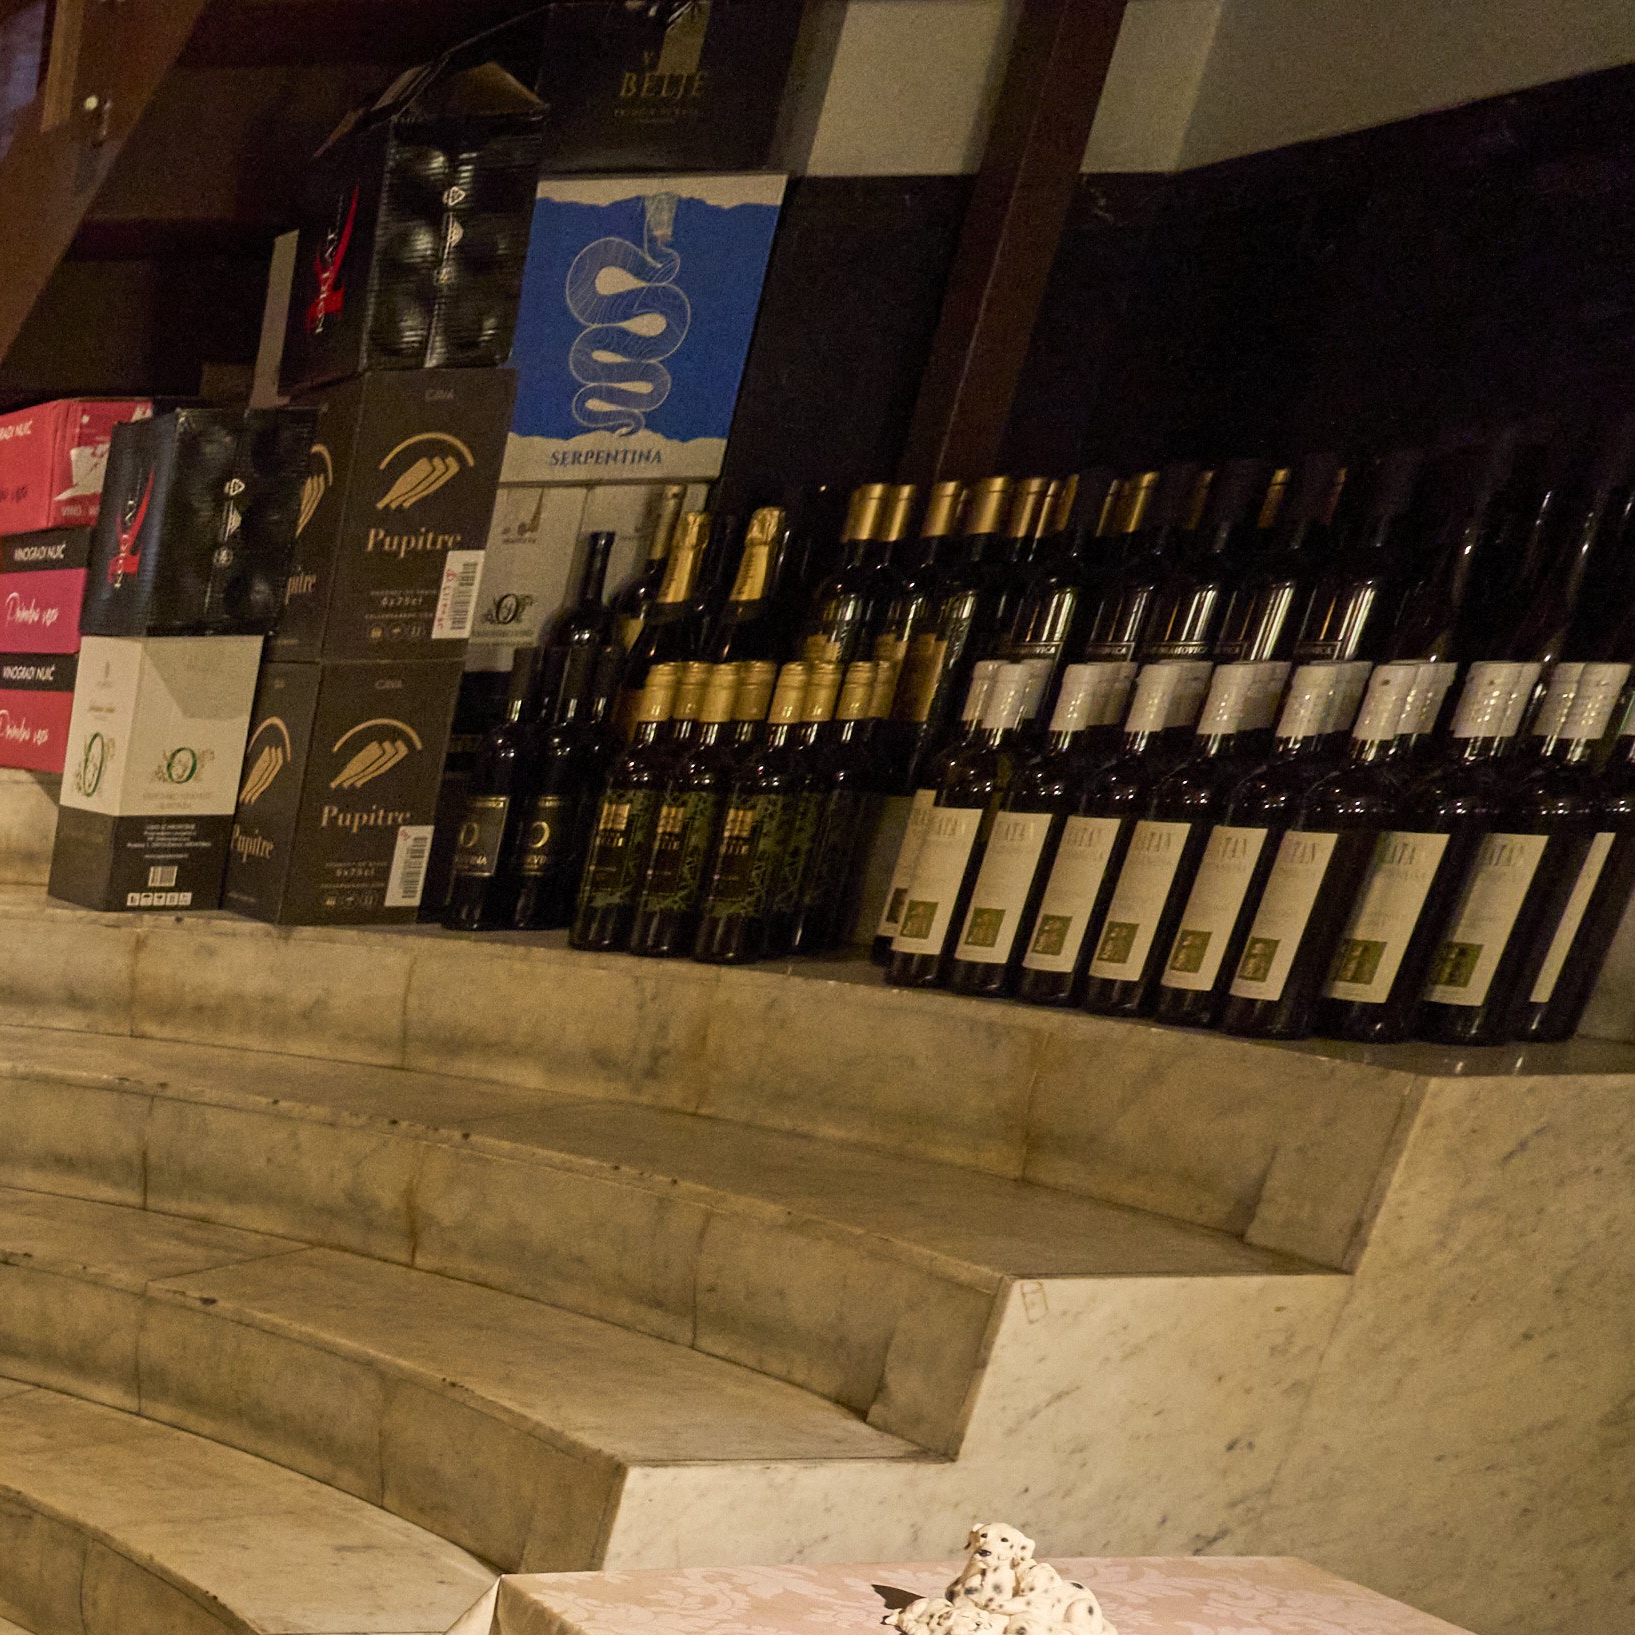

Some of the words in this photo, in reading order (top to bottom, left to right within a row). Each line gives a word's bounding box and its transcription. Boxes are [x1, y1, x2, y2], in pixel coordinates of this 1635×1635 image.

[549, 448, 663, 467] SERPENTINA
[367, 528, 462, 558] Pupitre
[320, 804, 411, 833] Pupitre
